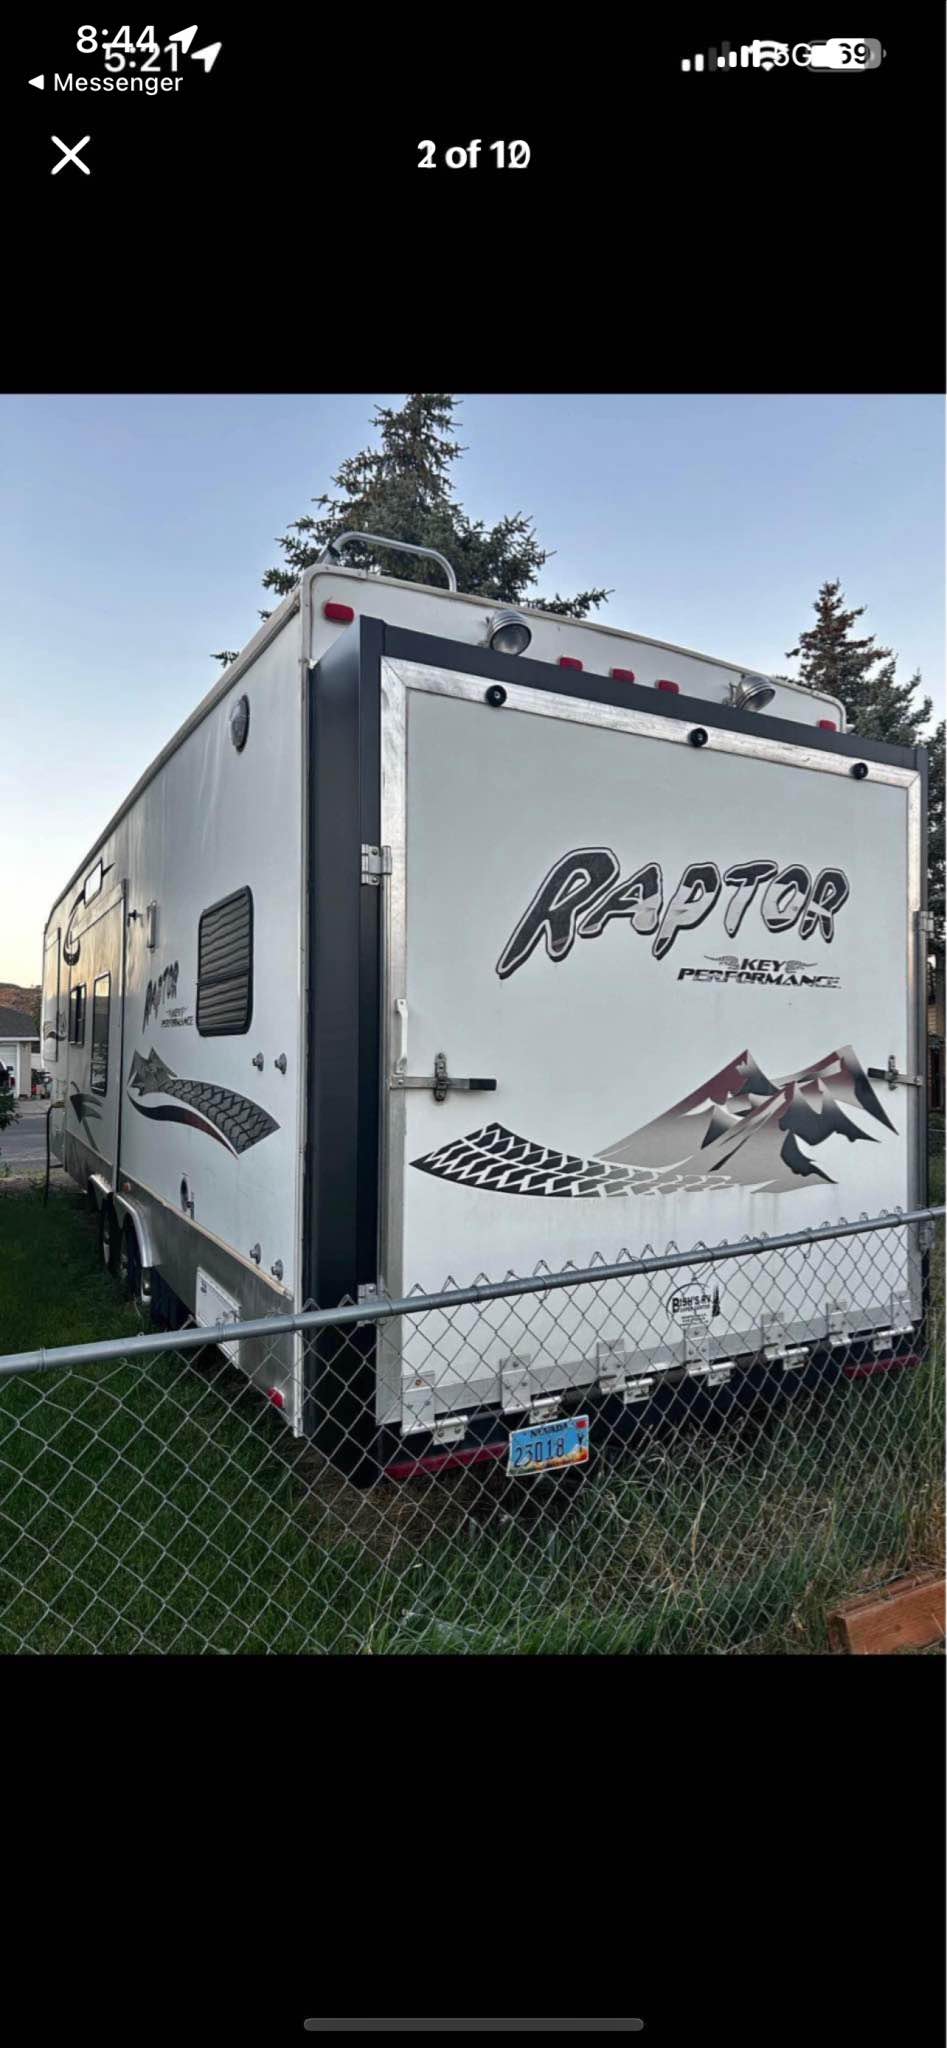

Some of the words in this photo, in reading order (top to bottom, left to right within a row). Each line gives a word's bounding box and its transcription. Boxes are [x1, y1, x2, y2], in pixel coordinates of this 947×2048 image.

[496, 847, 849, 980] RAPTOR
[740, 958, 786, 972] KEY
[677, 967, 842, 989] PERFORMANCE
[530, 1423, 568, 1437] NEVADA
